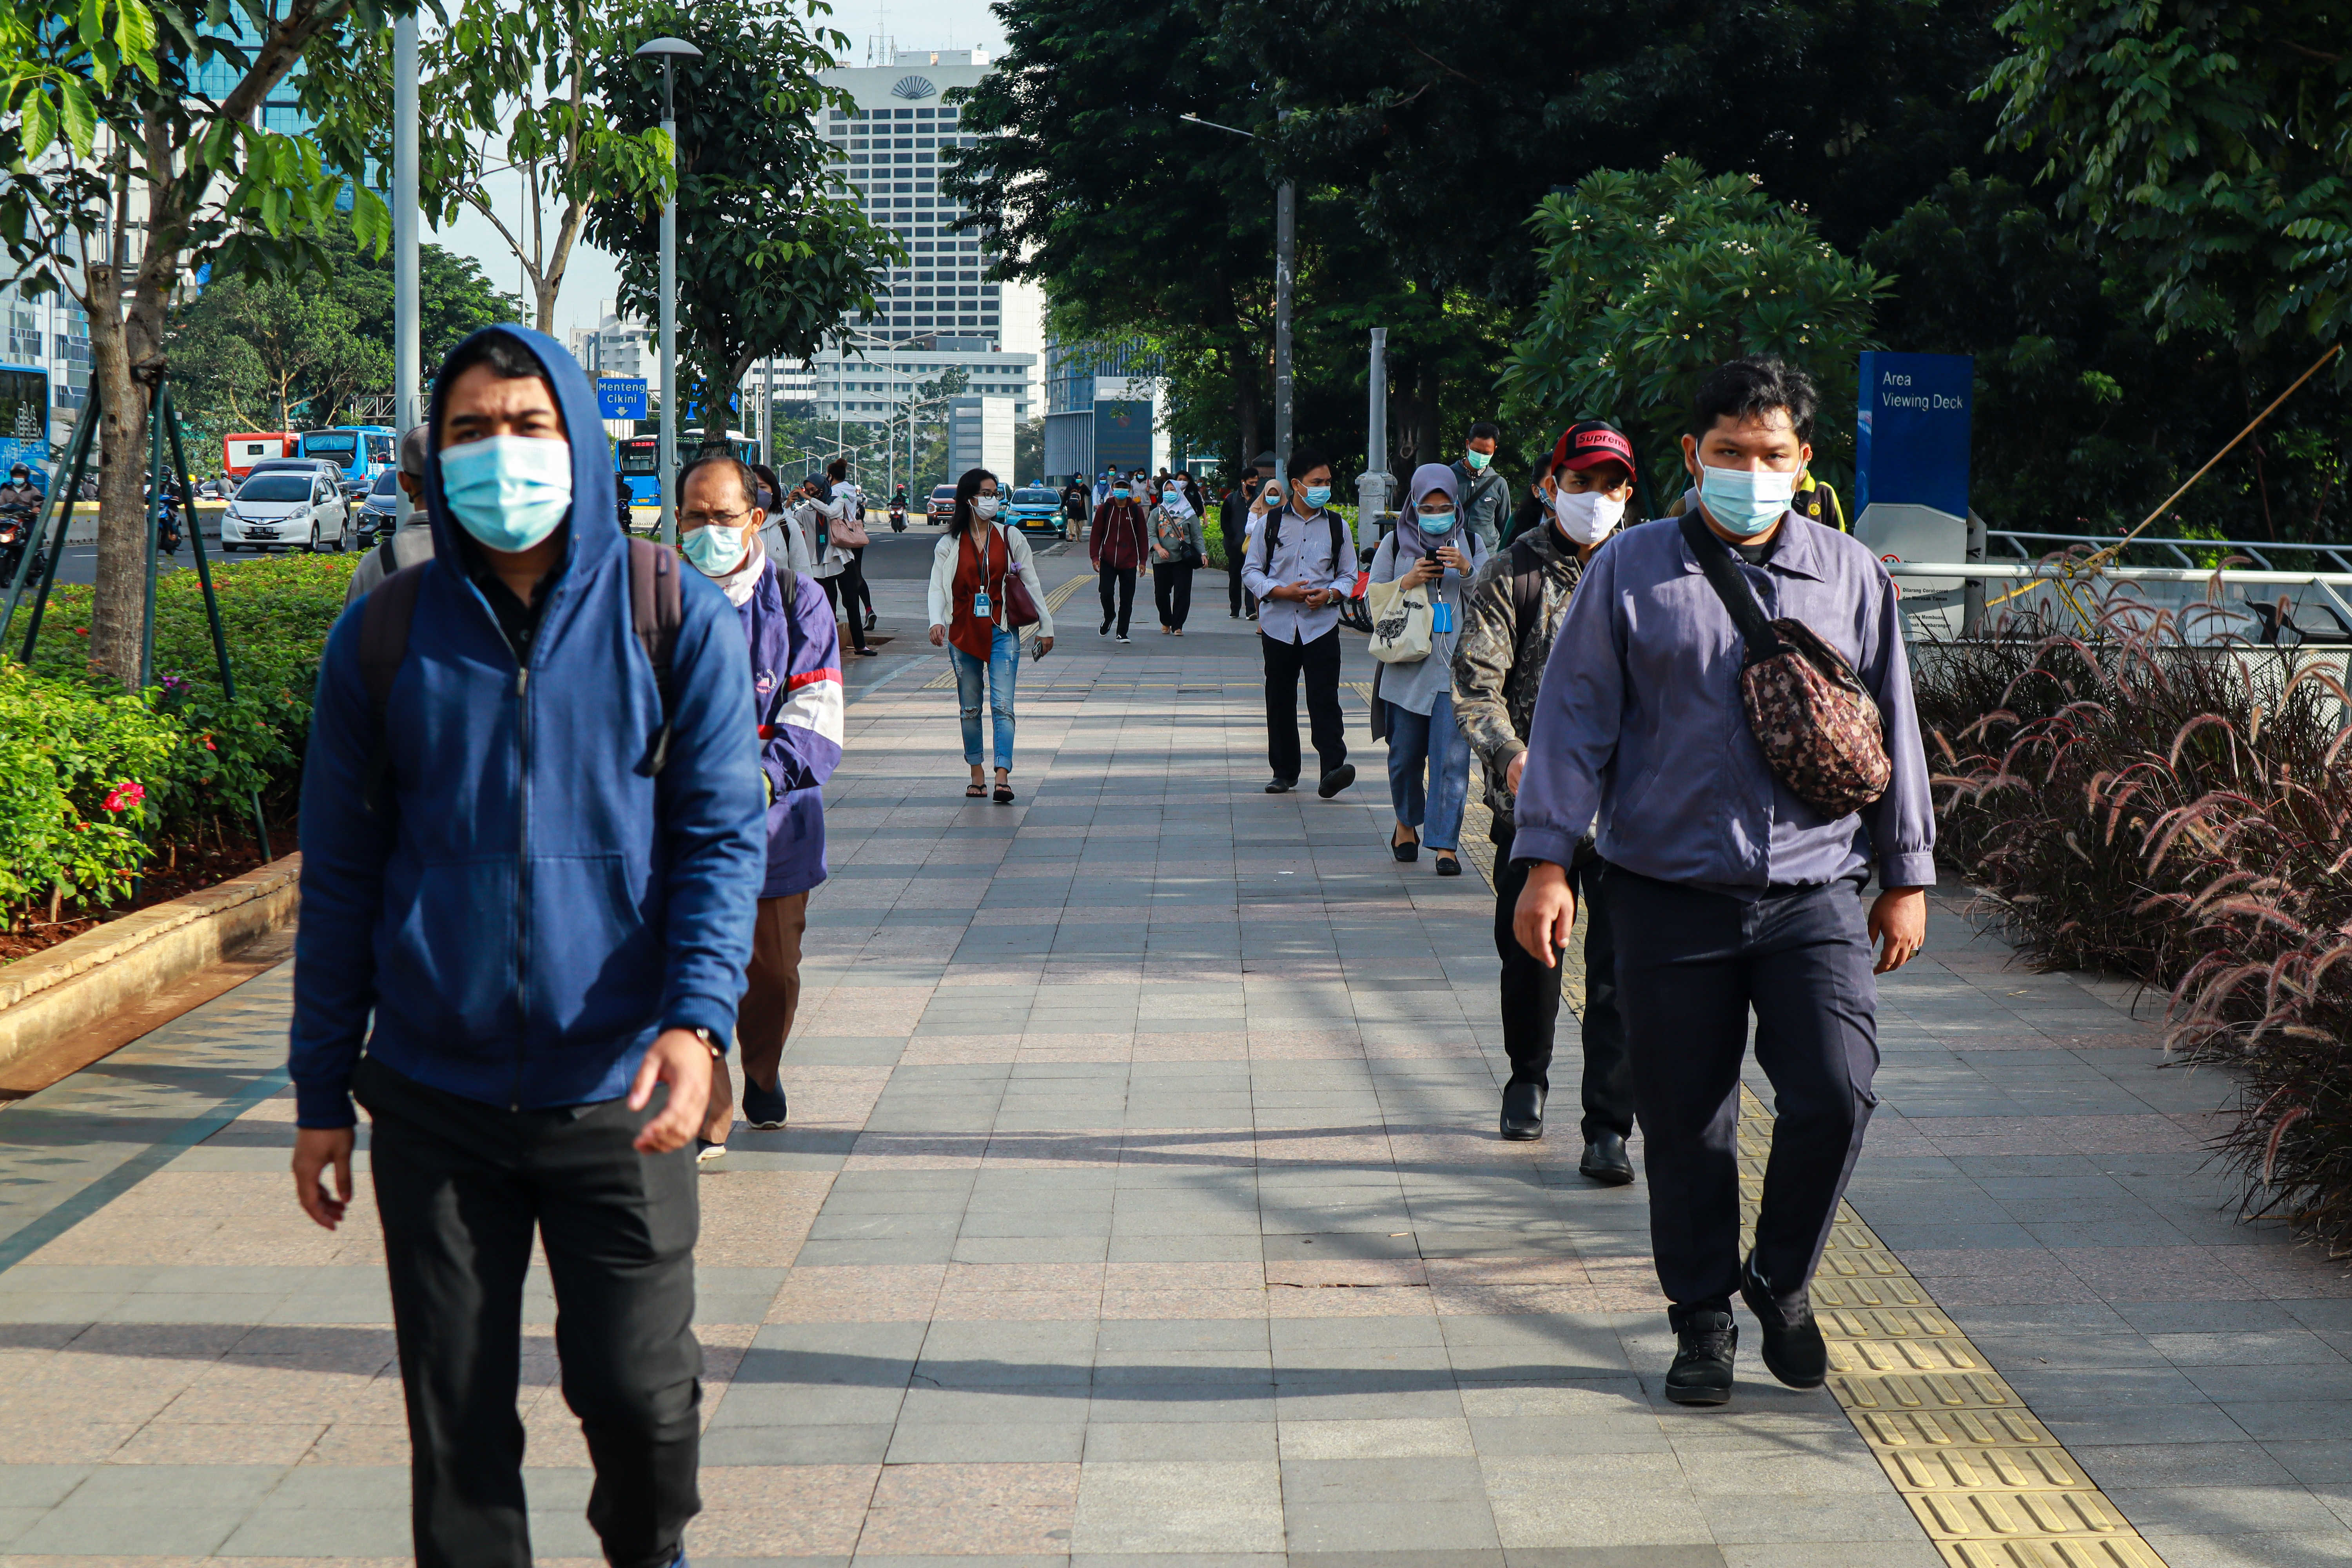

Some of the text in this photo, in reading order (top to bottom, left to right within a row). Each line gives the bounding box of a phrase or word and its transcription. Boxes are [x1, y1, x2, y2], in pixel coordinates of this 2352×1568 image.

[1883, 371, 1911, 386] Area
[599, 383, 645, 394] Menteng
[607, 394, 637, 403] Cikini
[1883, 392, 1962, 411] Viewing Deck
[1578, 434, 1628, 450] Supreme
